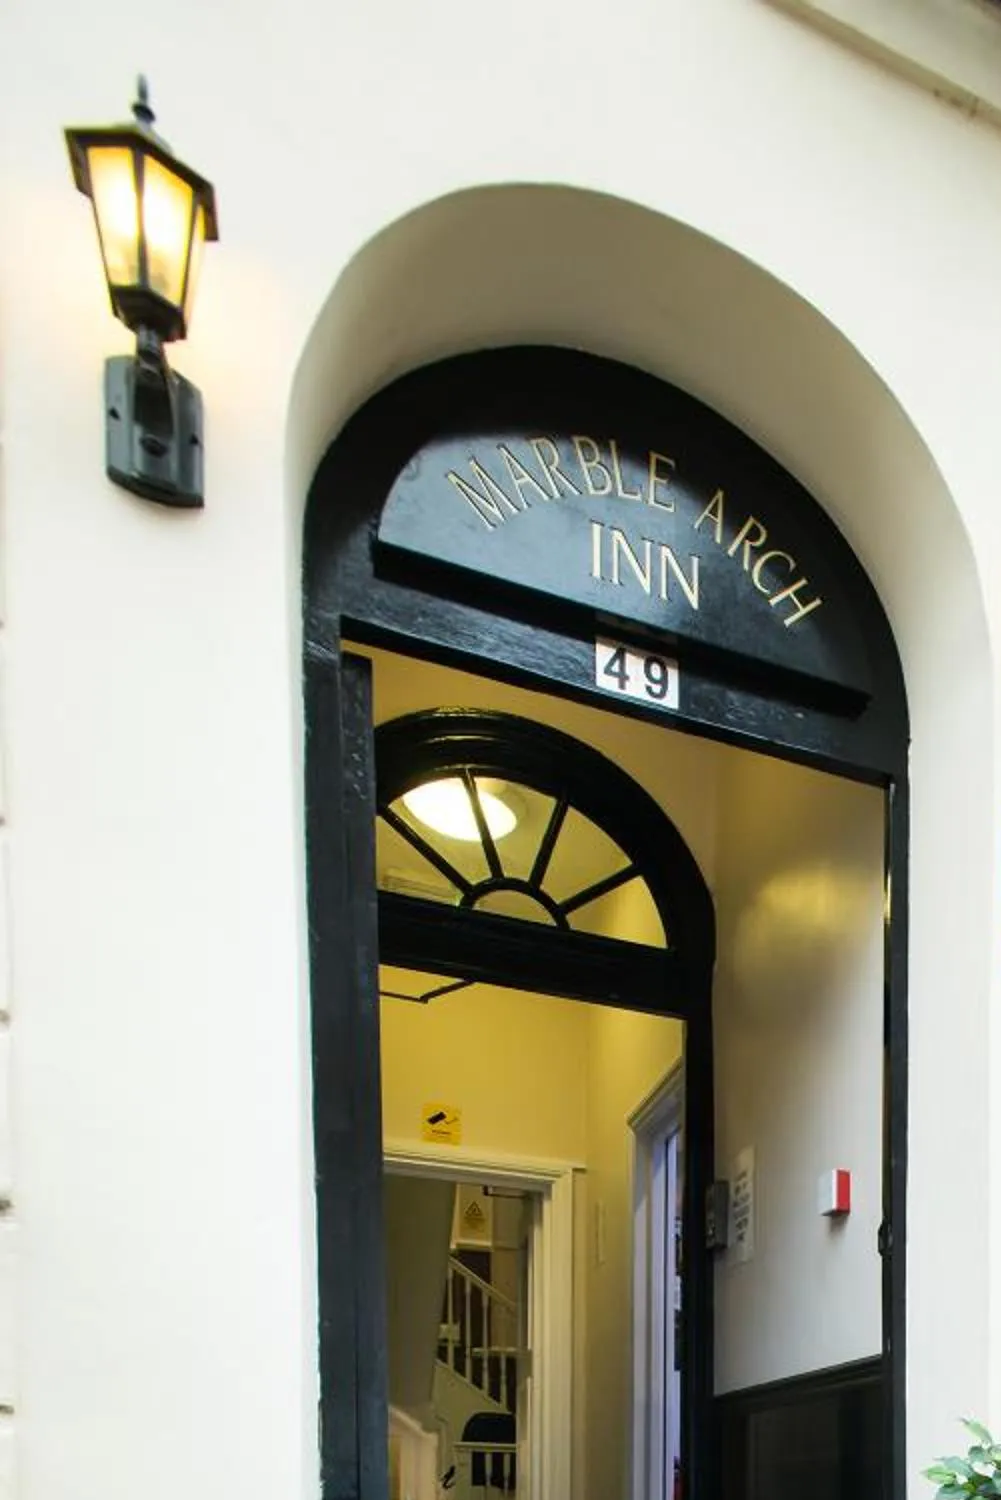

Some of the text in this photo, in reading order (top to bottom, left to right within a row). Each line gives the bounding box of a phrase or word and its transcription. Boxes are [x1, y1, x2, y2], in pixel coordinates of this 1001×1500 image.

[445, 434, 822, 628] MARBLE ARCH
[588, 520, 703, 610] INN
[603, 646, 669, 699] 49
